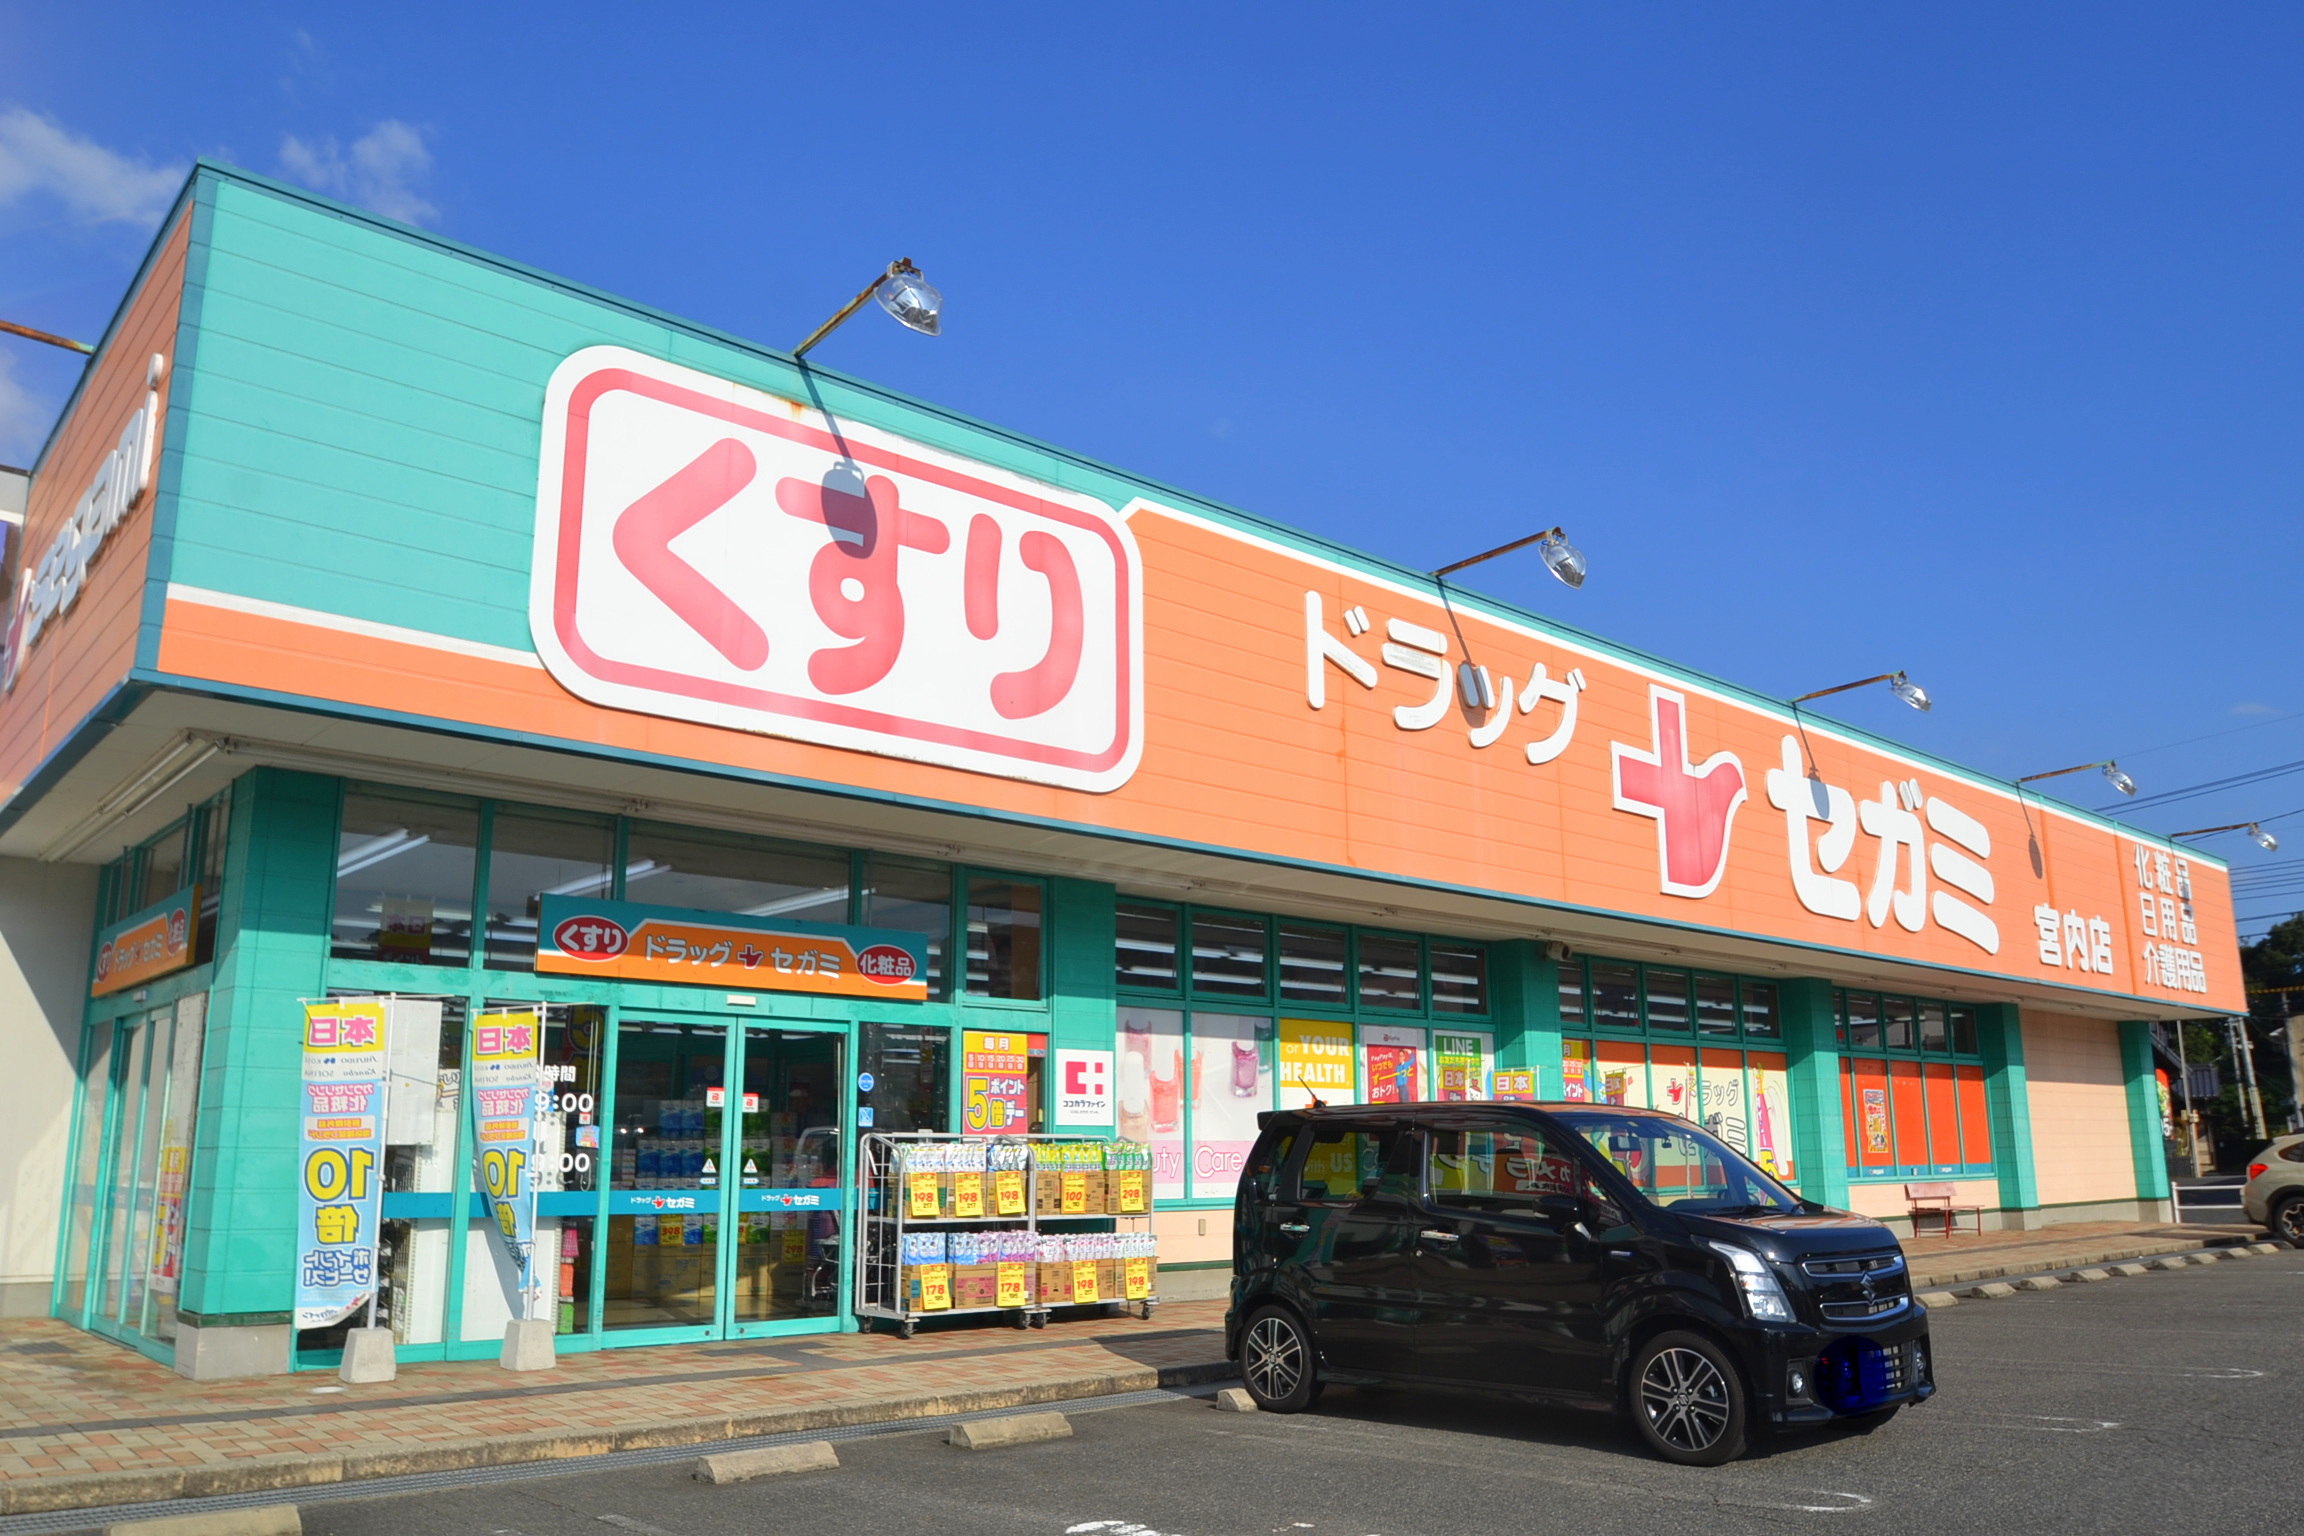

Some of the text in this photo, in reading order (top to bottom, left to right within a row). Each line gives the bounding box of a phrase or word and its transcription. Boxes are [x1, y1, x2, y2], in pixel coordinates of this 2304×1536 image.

[612, 437, 1084, 720] くすり
[1305, 590, 1999, 955] ドラッグ セガミ
[2134, 843, 2192, 901] 化粧品
[2138, 891, 2198, 945] 日用品
[560, 924, 622, 953] くすり
[2033, 903, 2113, 974] 宮内店
[646, 935, 841, 978] ドラッグ セガミ
[860, 952, 912, 978] 化粧品
[2142, 940, 2207, 994] 介護用品
[1299, 1034, 1350, 1056] YOUR
[1443, 1037, 1474, 1056] LINE
[1280, 1061, 1350, 1086] HEALTH,
[991, 1077, 1025, 1095] ポイント
[967, 1076, 989, 1130] 5
[1063, 1100, 1106, 1108] ココカラファイン
[1195, 1145, 1243, 1179] Care
[1330, 1152, 1353, 1172] US
[666, 1197, 695, 1208] セガミ
[794, 1195, 820, 1206] セガミ
[914, 1192, 934, 1202] 198
[958, 1192, 978, 1203] 198
[1000, 1190, 1019, 1201] 198
[1065, 1191, 1082, 1201] 100
[1122, 1189, 1140, 1199] 298
[925, 1284, 945, 1295] 178
[1000, 1282, 1020, 1293] 178
[1077, 1279, 1094, 1290] 198
[1128, 1276, 1145, 1286] 198
